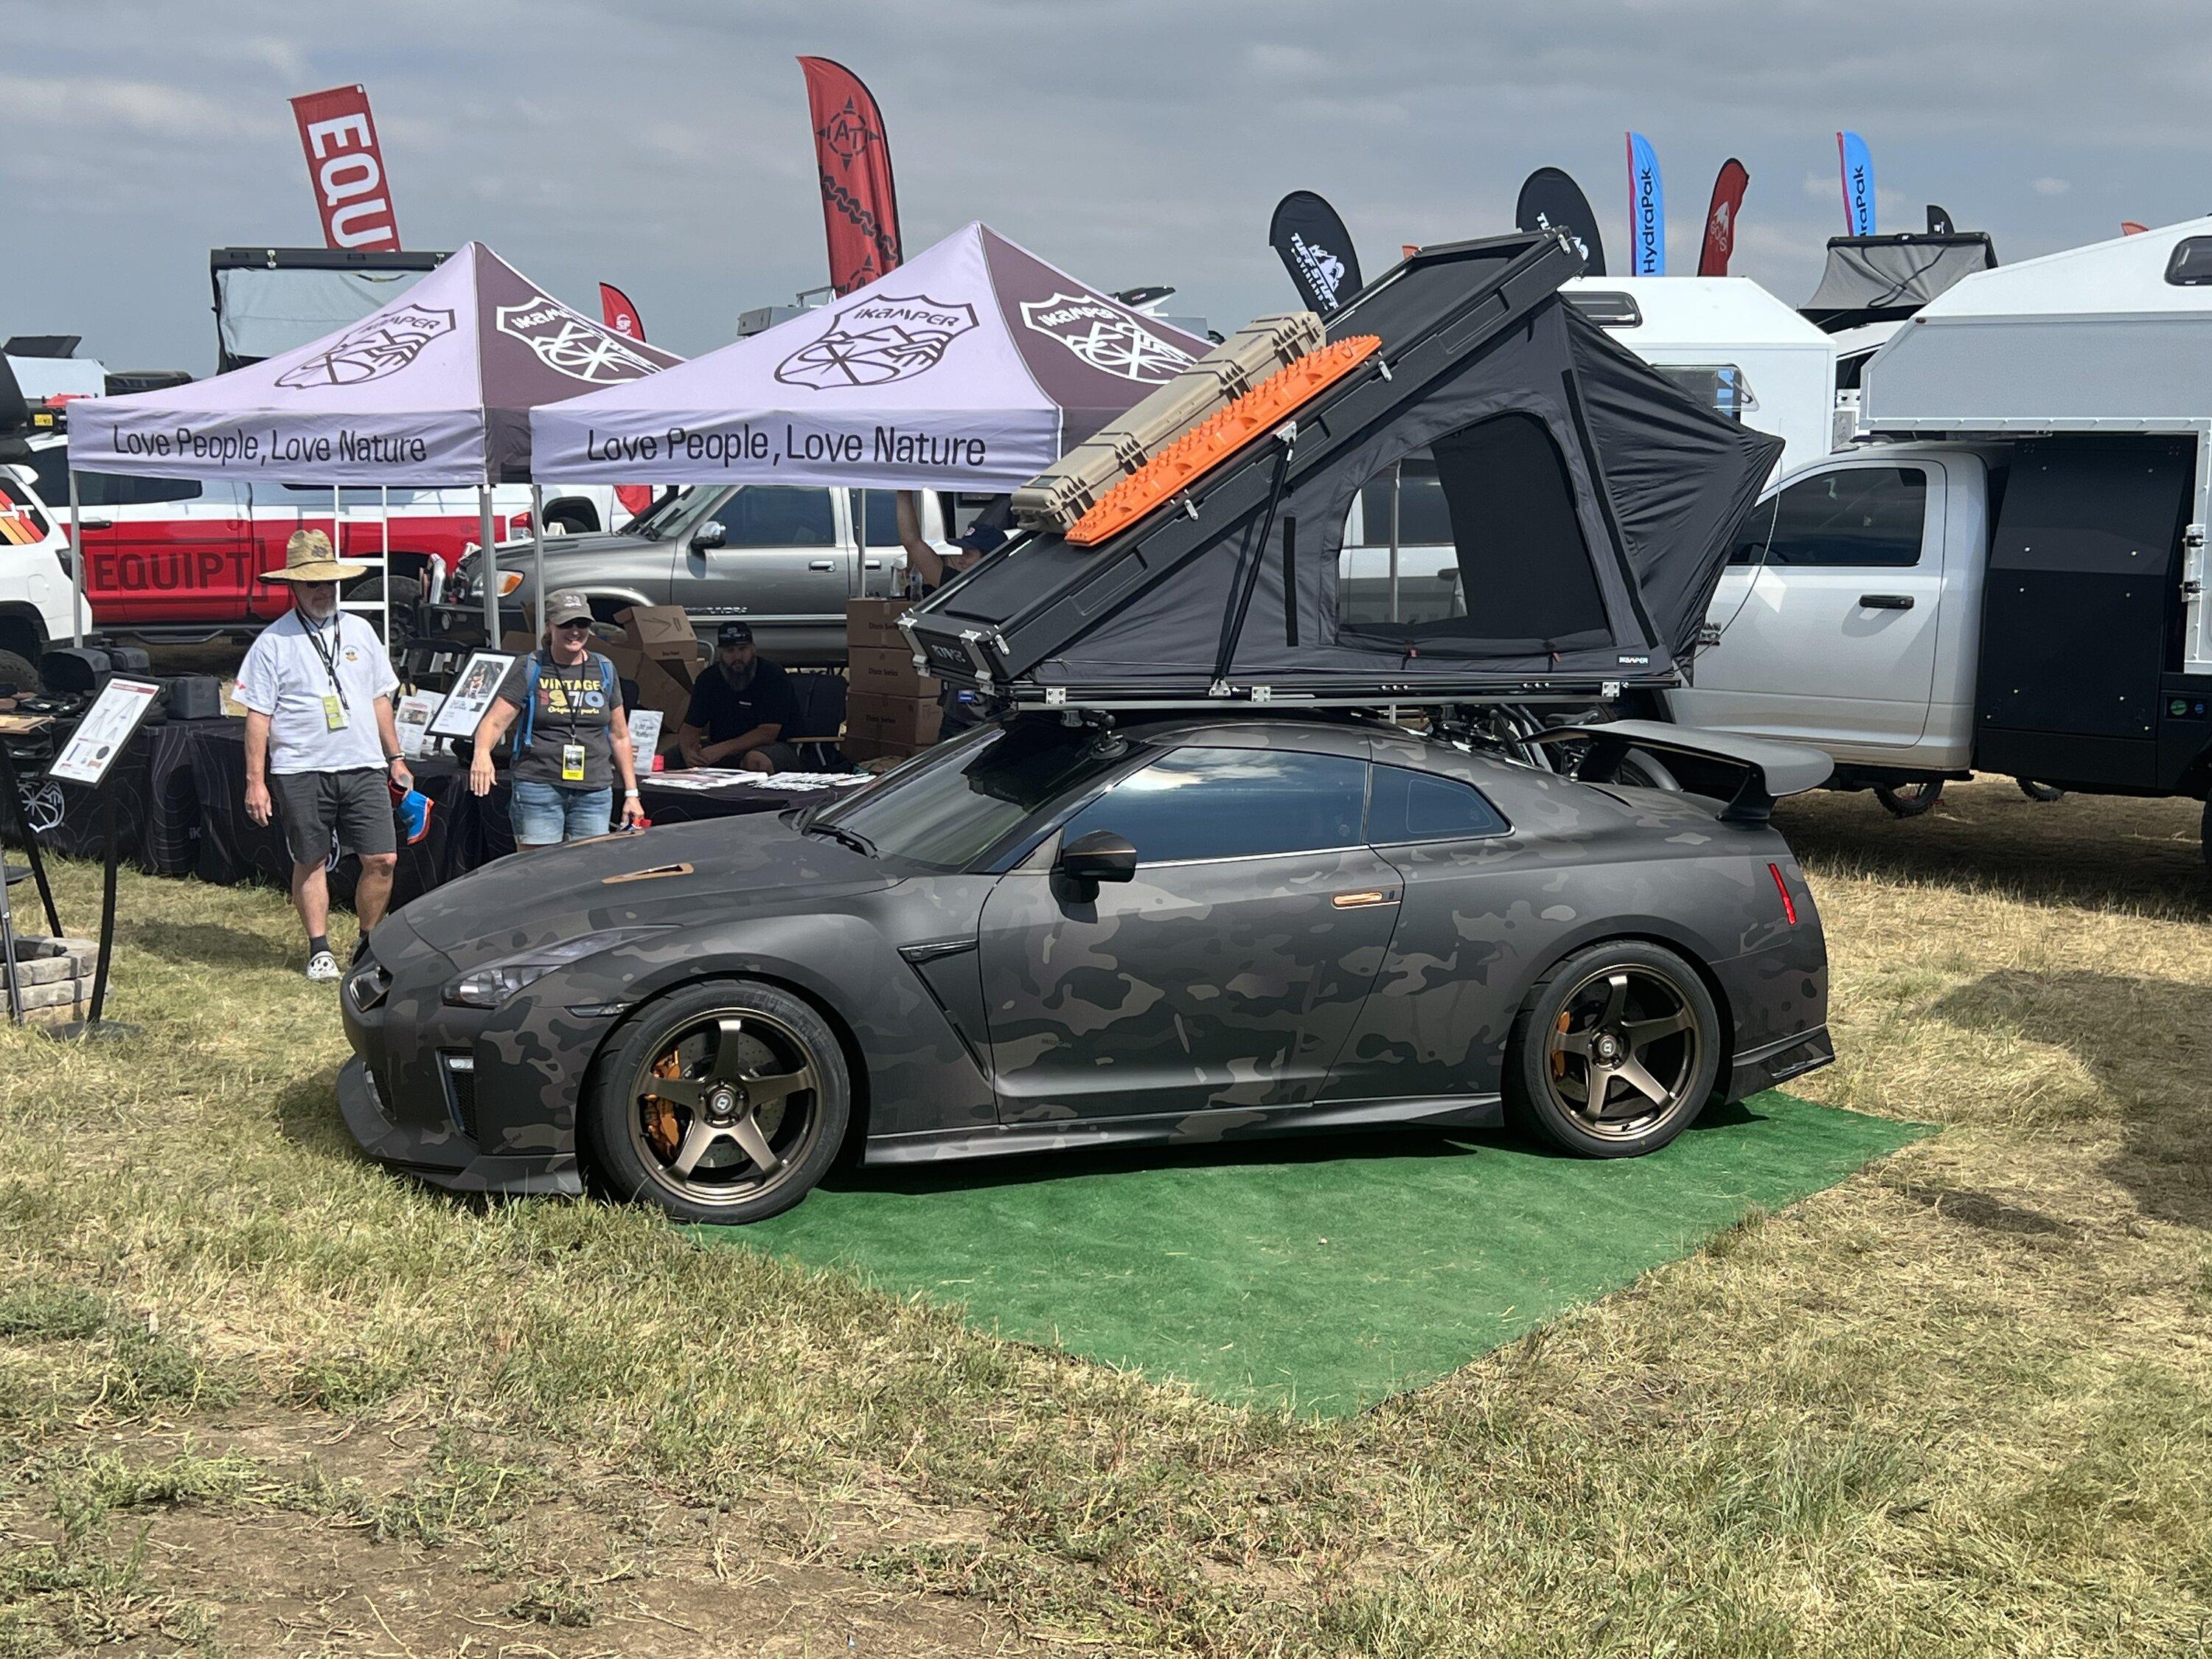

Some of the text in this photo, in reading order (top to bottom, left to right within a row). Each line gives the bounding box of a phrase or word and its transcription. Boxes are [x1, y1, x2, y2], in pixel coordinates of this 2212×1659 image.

[307, 112, 396, 252] EQU
[1641, 166, 1658, 274] HydraPak
[1295, 257, 1324, 302] OVERLAND
[114, 425, 428, 467] Love People, Love Nature
[587, 423, 987, 467] Love People, Love Nature
[93, 552, 251, 591] EQUIPT
[539, 678, 601, 691] VINTAGE
[539, 689, 605, 708] 1970
